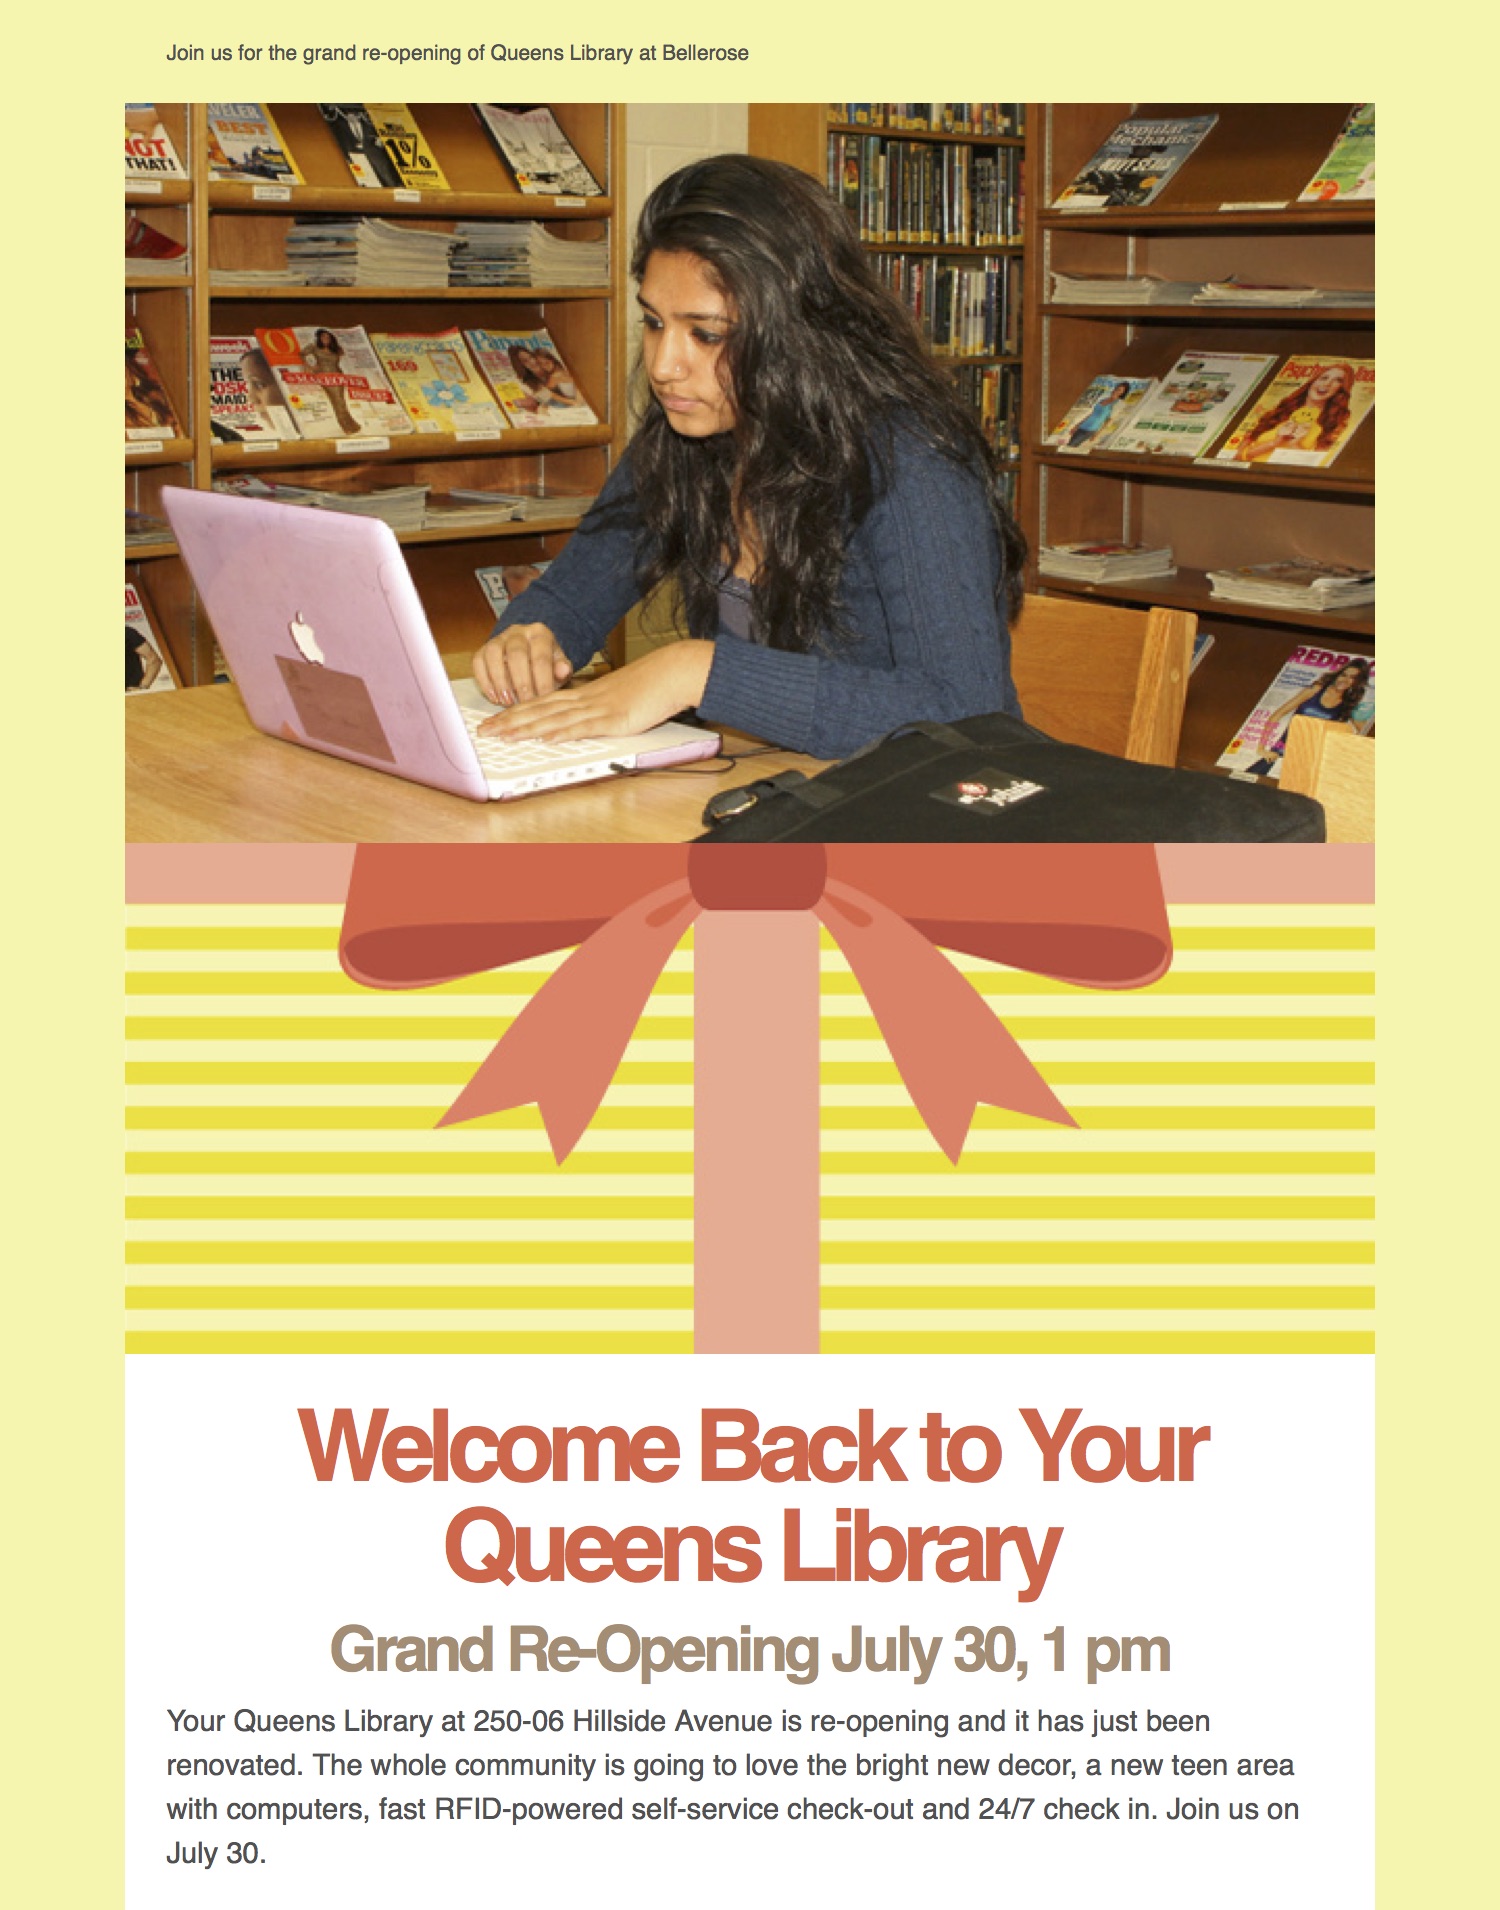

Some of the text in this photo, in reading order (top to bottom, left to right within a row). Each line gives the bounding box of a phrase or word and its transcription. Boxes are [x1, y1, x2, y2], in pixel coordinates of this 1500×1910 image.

[214, 120, 268, 135] BEST
[1118, 123, 1190, 135] Popular
[125, 158, 177, 172] THAT!
[210, 367, 245, 381] THE
